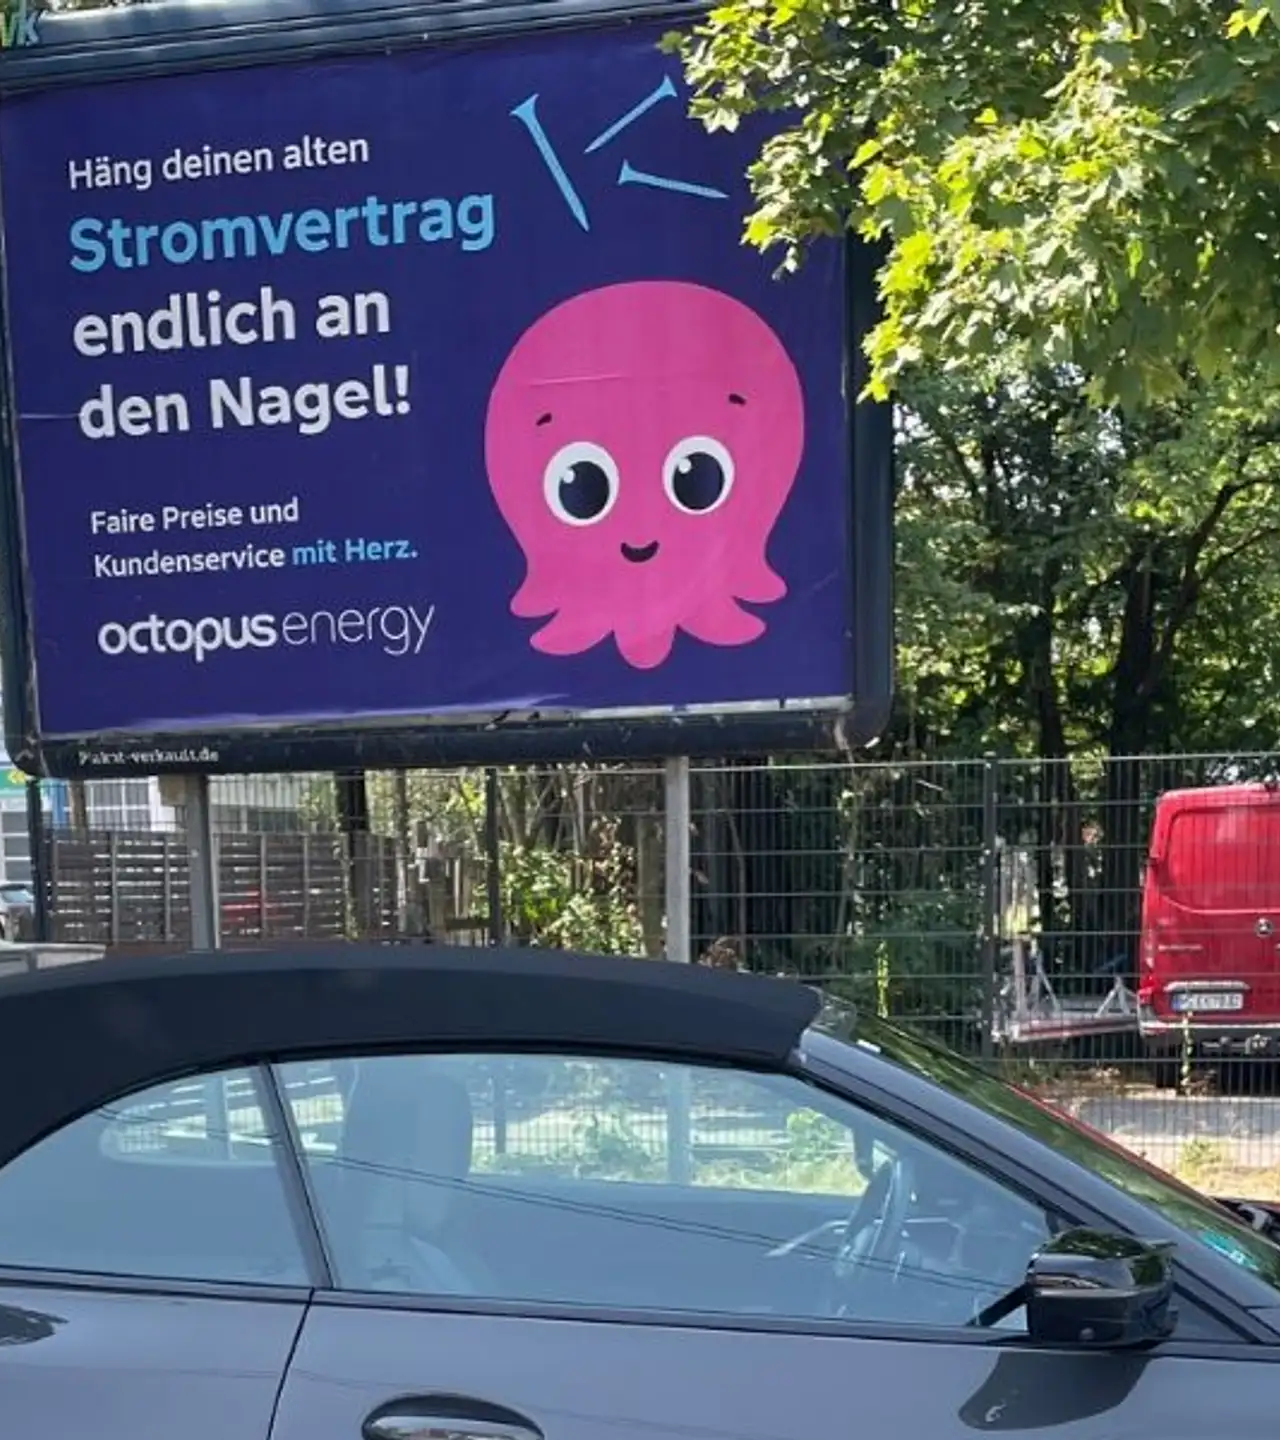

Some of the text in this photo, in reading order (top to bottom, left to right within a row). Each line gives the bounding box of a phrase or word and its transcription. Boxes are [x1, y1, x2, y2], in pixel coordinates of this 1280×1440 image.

[68, 134, 369, 190] Häng deinen alten
[69, 193, 496, 272] Stromvertrag
[73, 286, 391, 356] endlich an
[78, 363, 411, 439] den Nagel!
[91, 496, 300, 535] Faire Preise und
[94, 537, 419, 578] Kundenservice mit Herz.
[97, 604, 436, 663] octopus energy
